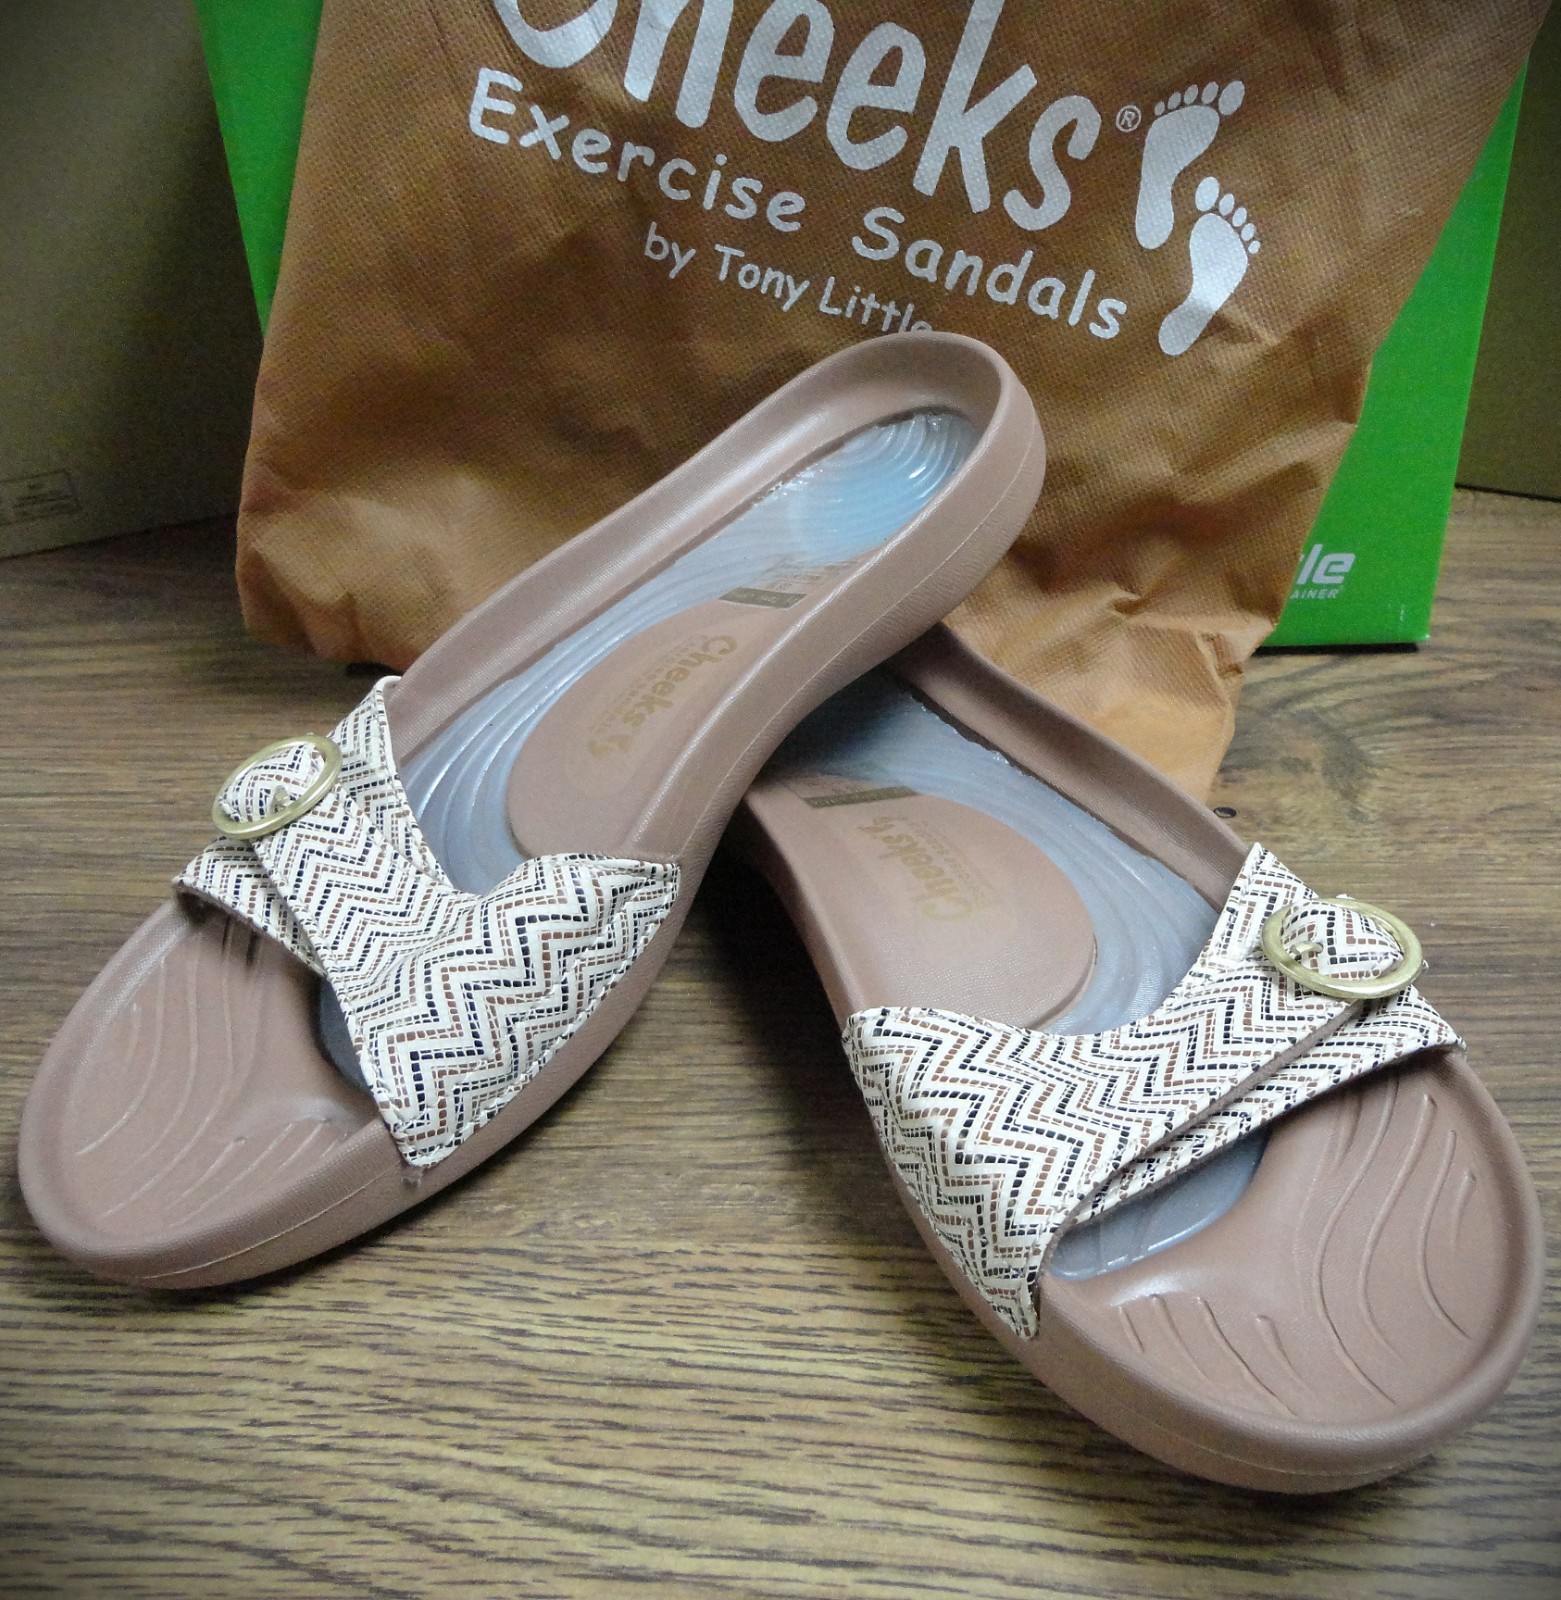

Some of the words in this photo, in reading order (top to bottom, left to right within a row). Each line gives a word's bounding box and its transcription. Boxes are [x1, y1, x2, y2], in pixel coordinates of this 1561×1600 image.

[468, 65, 806, 233] Exercise
[851, 206, 1128, 340] Sandals
[645, 221, 697, 279] by
[714, 243, 811, 313] Tony
[1296, 543, 1356, 585] le
[622, 634, 738, 728] Cheeks
